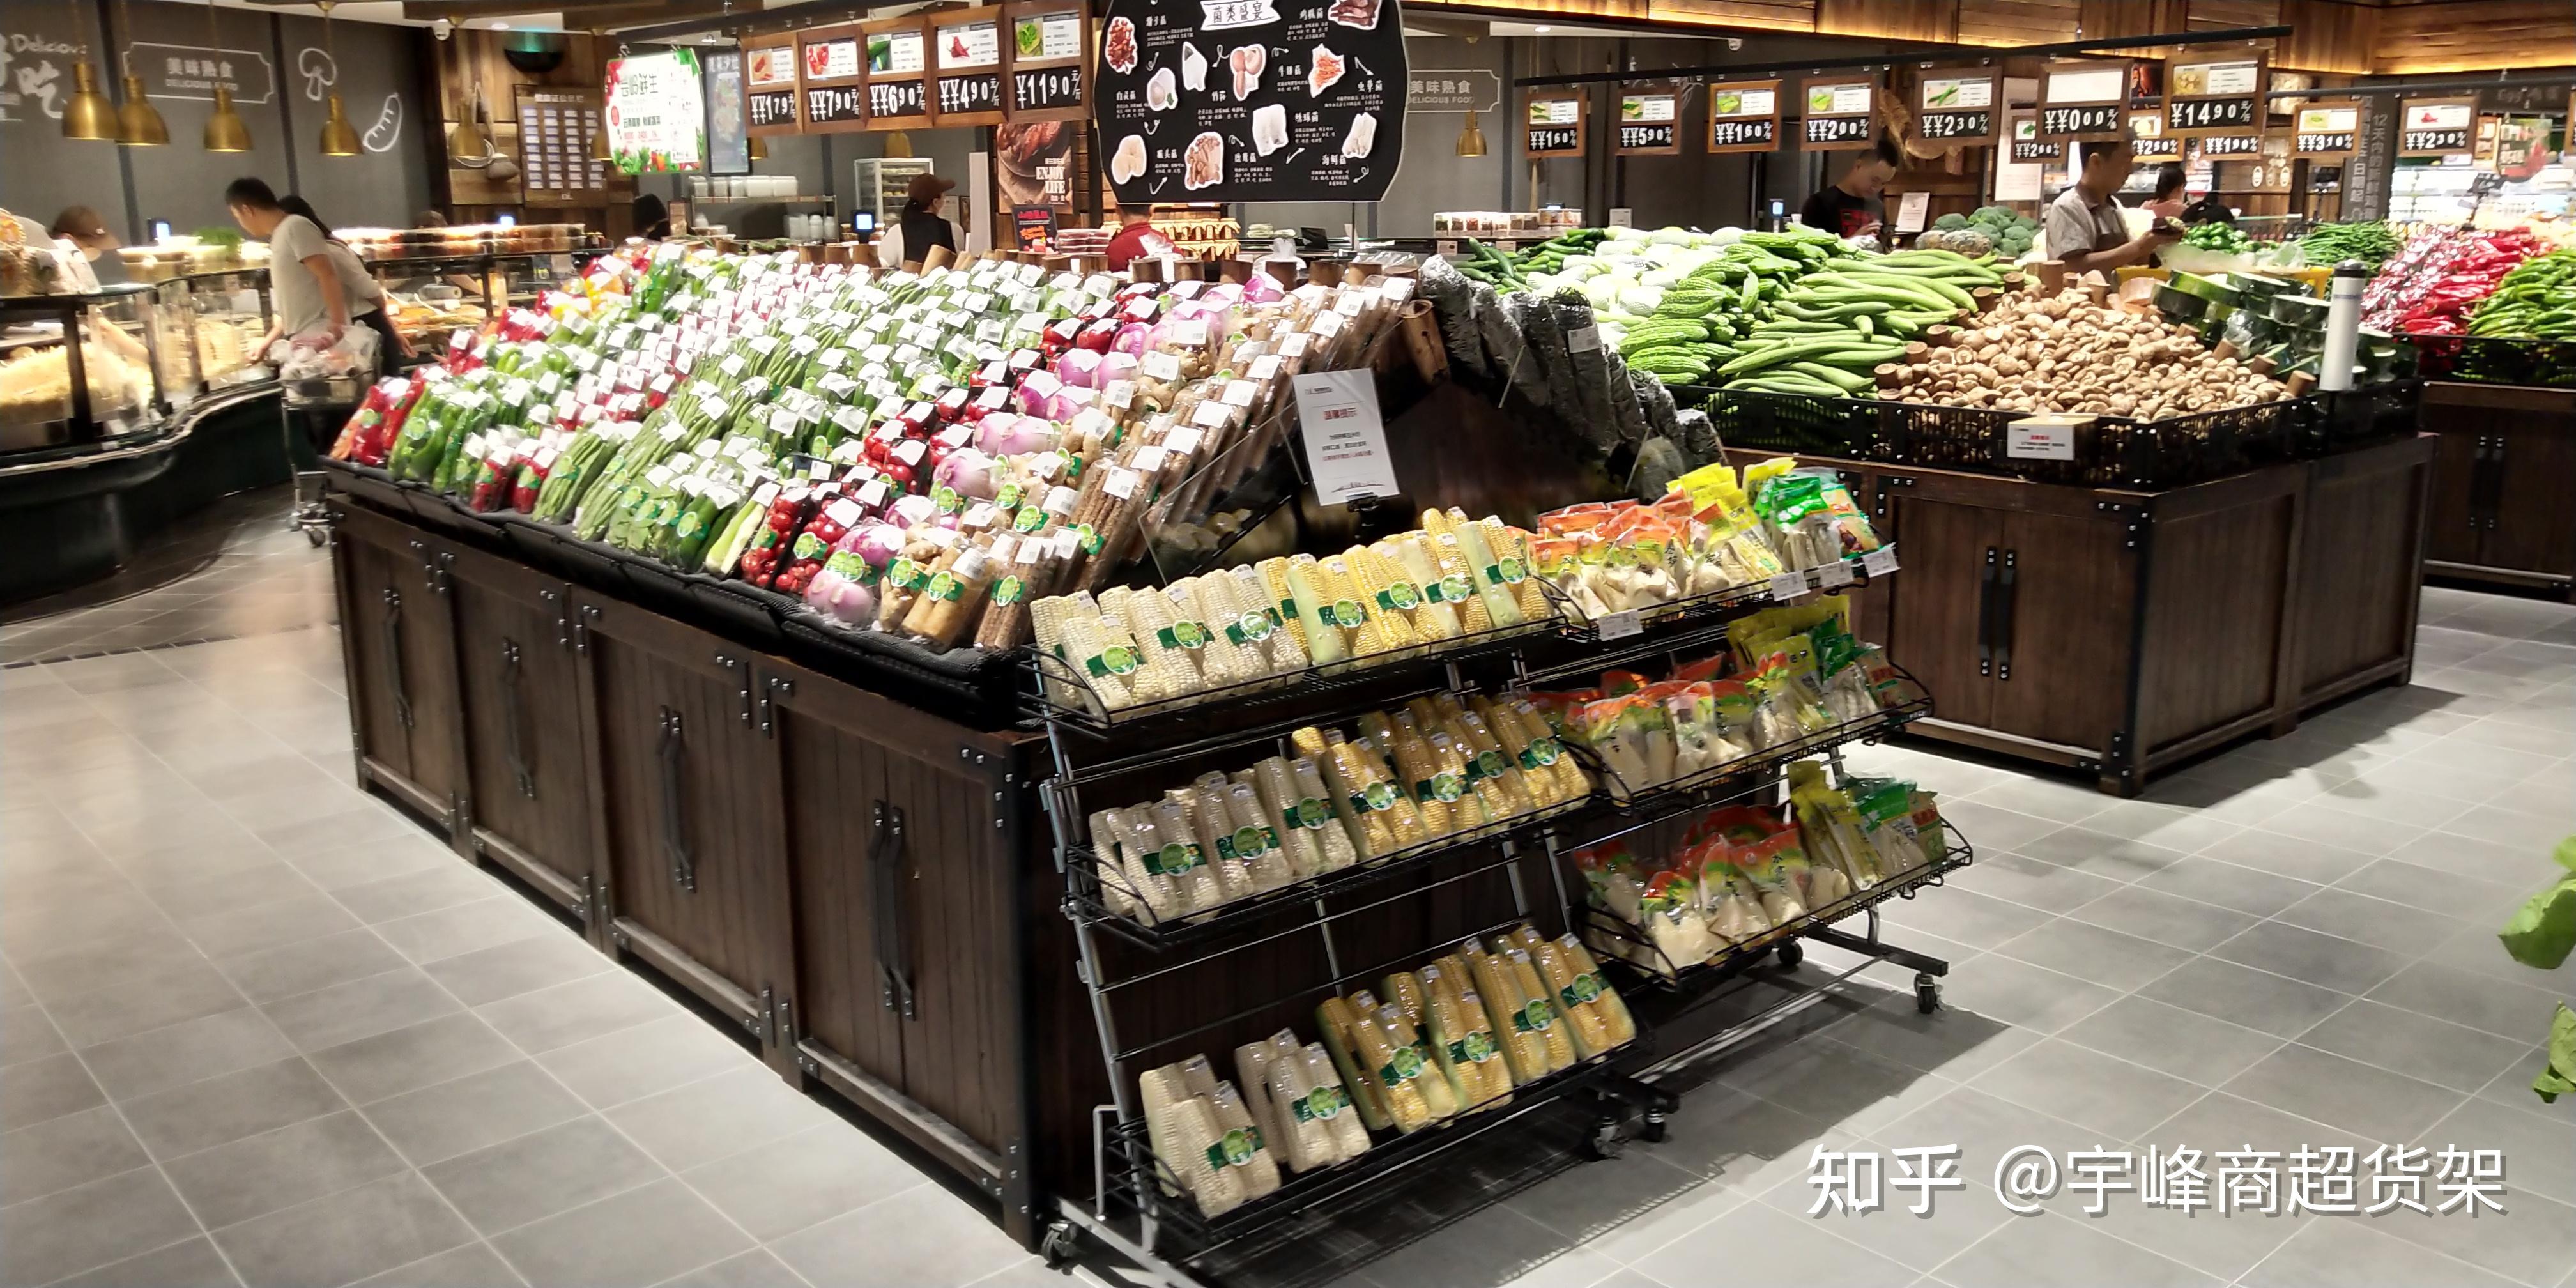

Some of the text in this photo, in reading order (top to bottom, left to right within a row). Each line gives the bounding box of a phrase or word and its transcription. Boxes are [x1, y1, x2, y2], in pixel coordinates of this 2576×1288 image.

[1213, 1, 1263, 24] 菌类盛宴
[166, 57, 234, 79] 美味熟食
[1410, 80, 1471, 94] 美味熟食
[1036, 166, 1065, 180] ENJOY
[1045, 180, 1065, 194] LIFE
